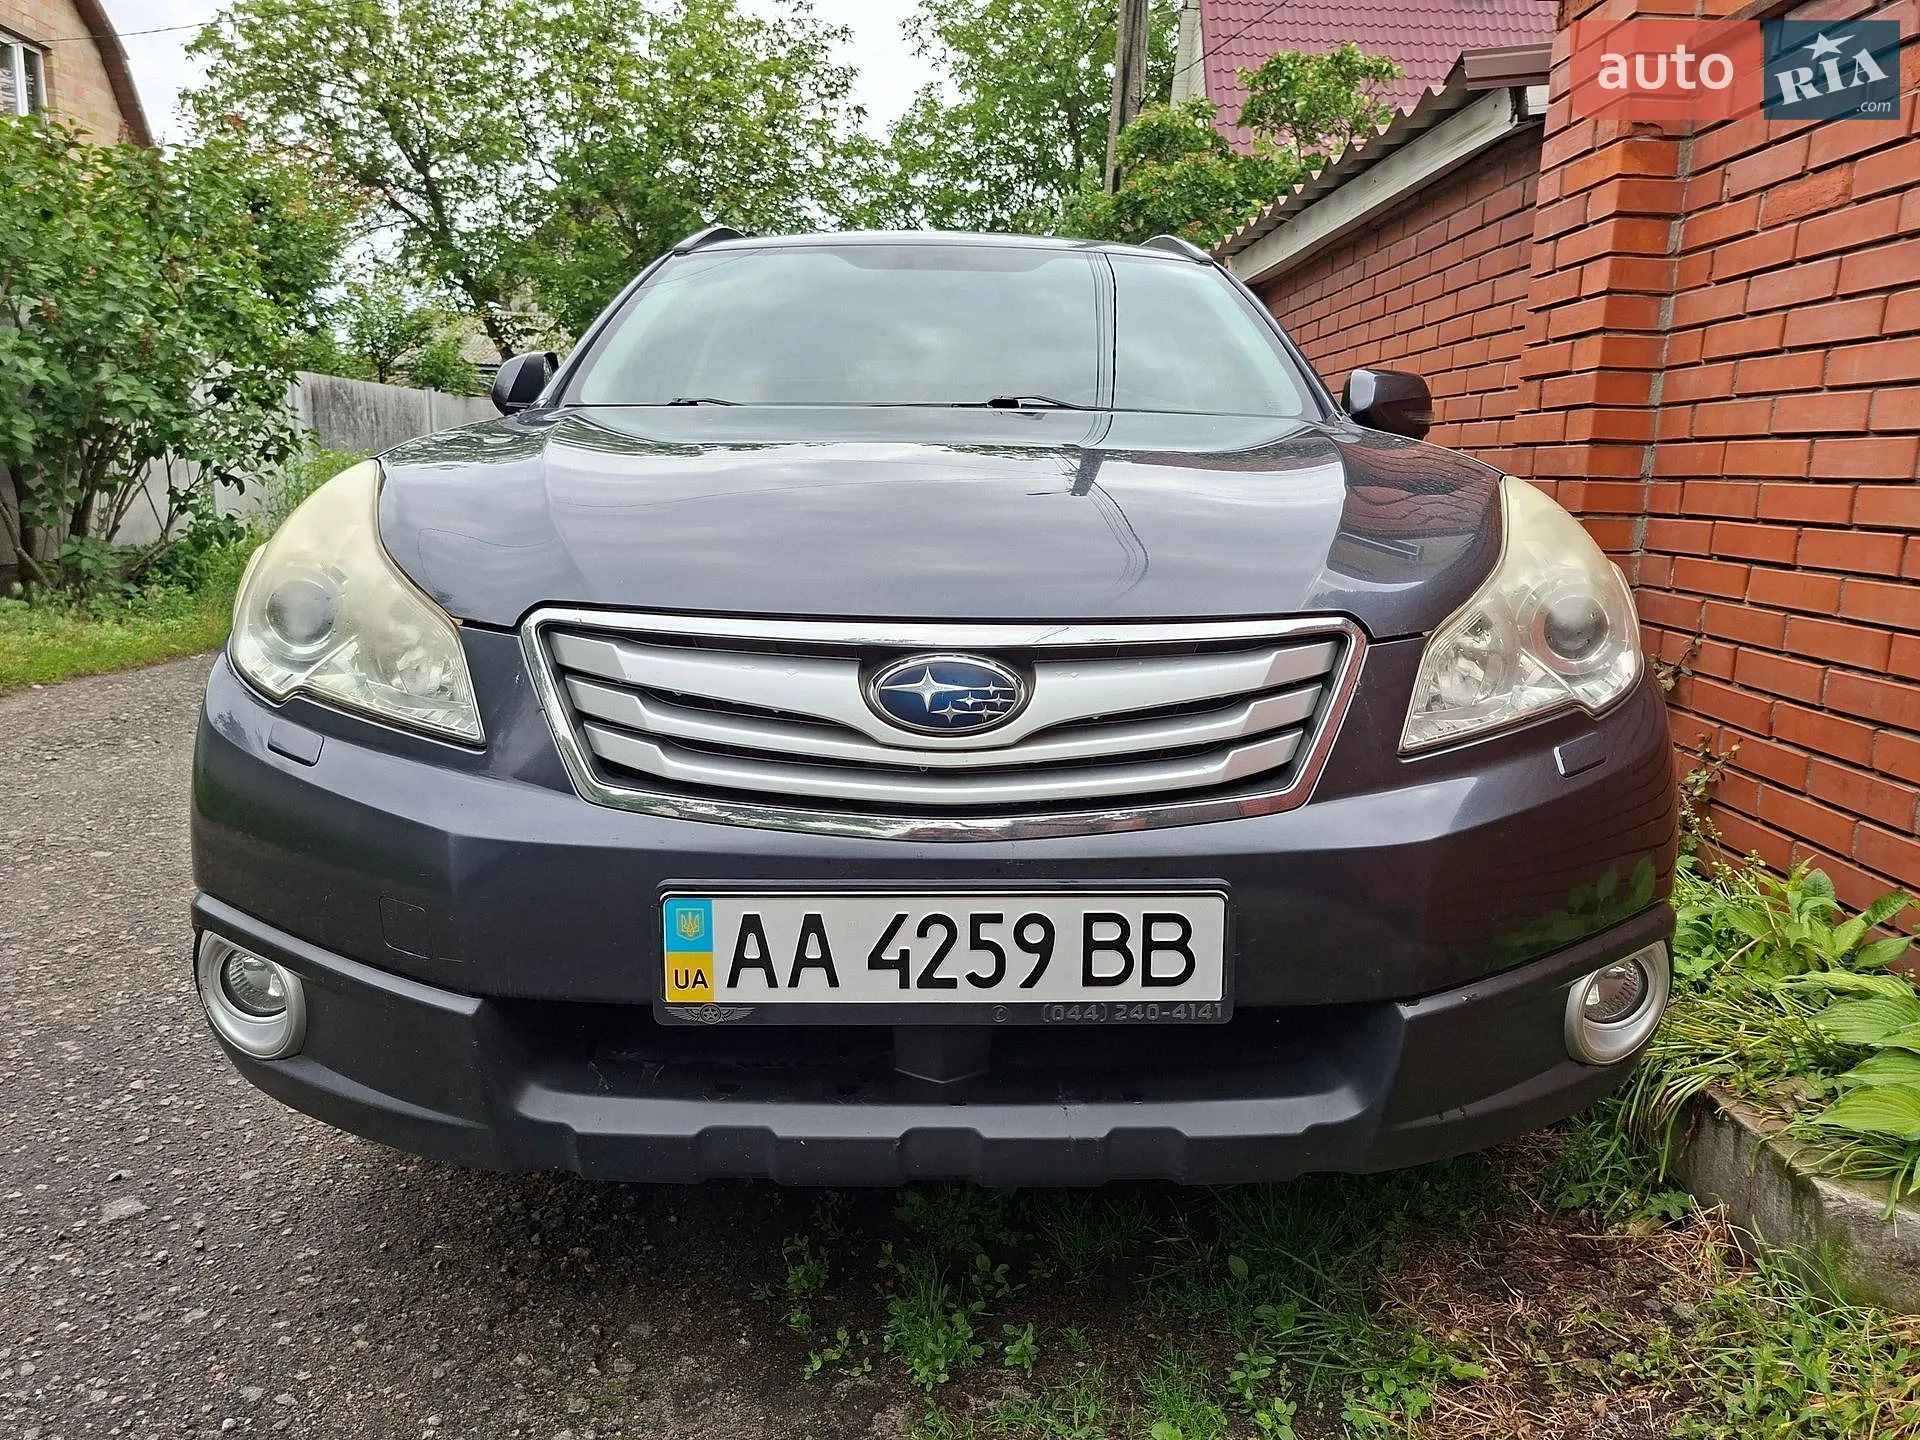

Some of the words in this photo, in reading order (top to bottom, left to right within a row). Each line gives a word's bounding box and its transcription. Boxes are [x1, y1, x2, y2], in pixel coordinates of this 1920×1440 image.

[726, 912, 840, 989] AA
[867, 911, 1056, 990] 4259
[1081, 911, 1197, 988] BB
[673, 968, 709, 990] UA
[1042, 1003, 1108, 1023] (044)
[1114, 1003, 1223, 1021] 240-4141
